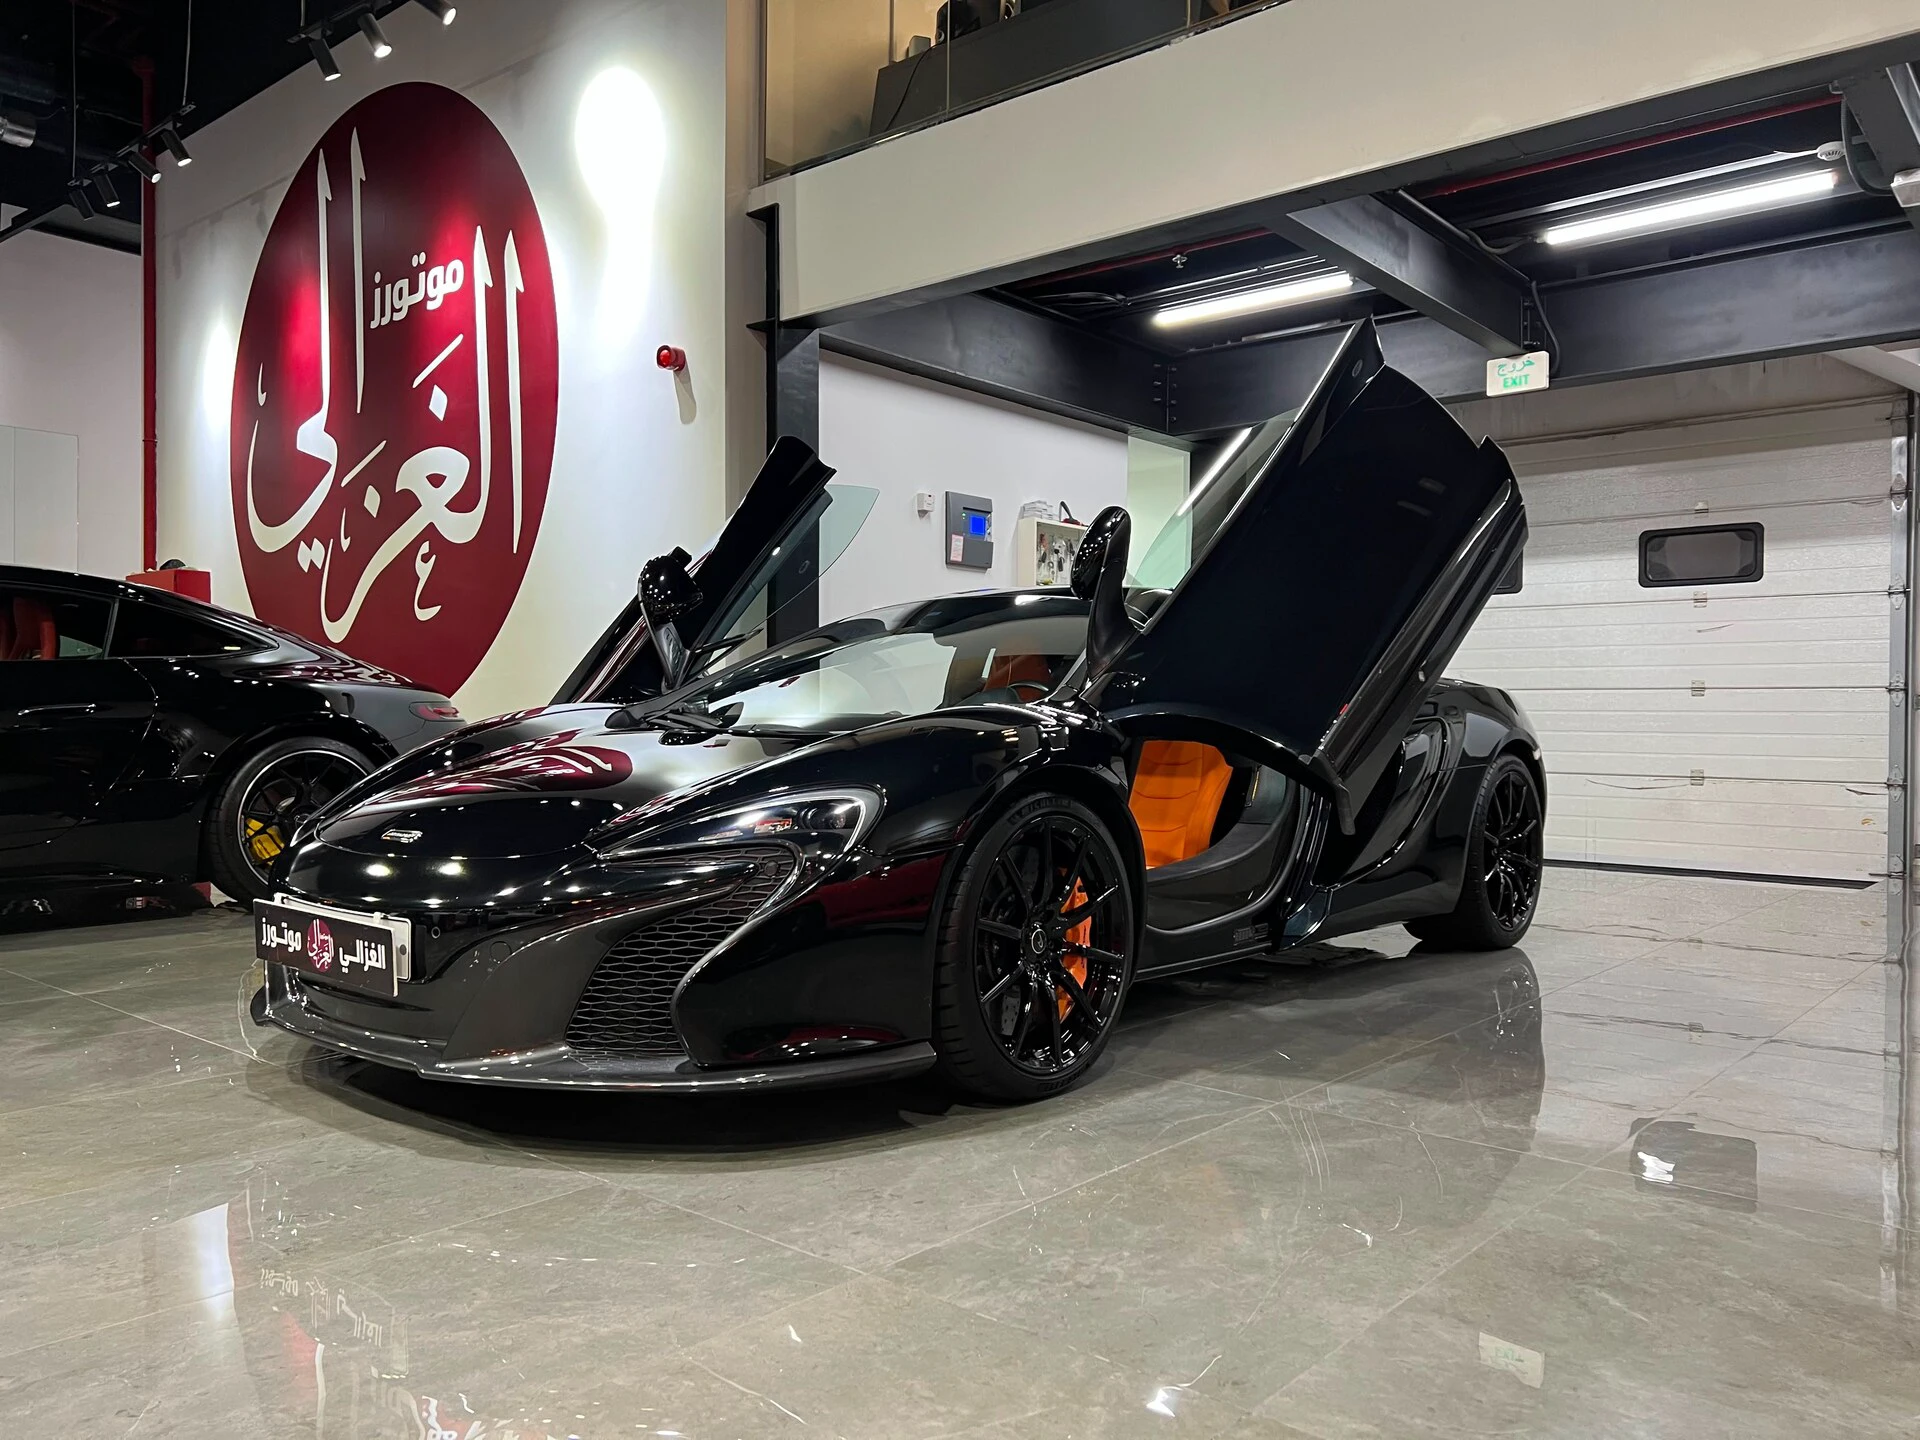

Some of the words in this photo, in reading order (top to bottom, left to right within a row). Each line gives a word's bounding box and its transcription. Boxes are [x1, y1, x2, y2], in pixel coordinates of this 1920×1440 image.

[370, 252, 464, 330] موتورز
[1497, 356, 1536, 377] خروج
[1503, 374, 1530, 389] EXIT
[261, 917, 302, 953] موتورز
[338, 939, 387, 974] الغزالي
